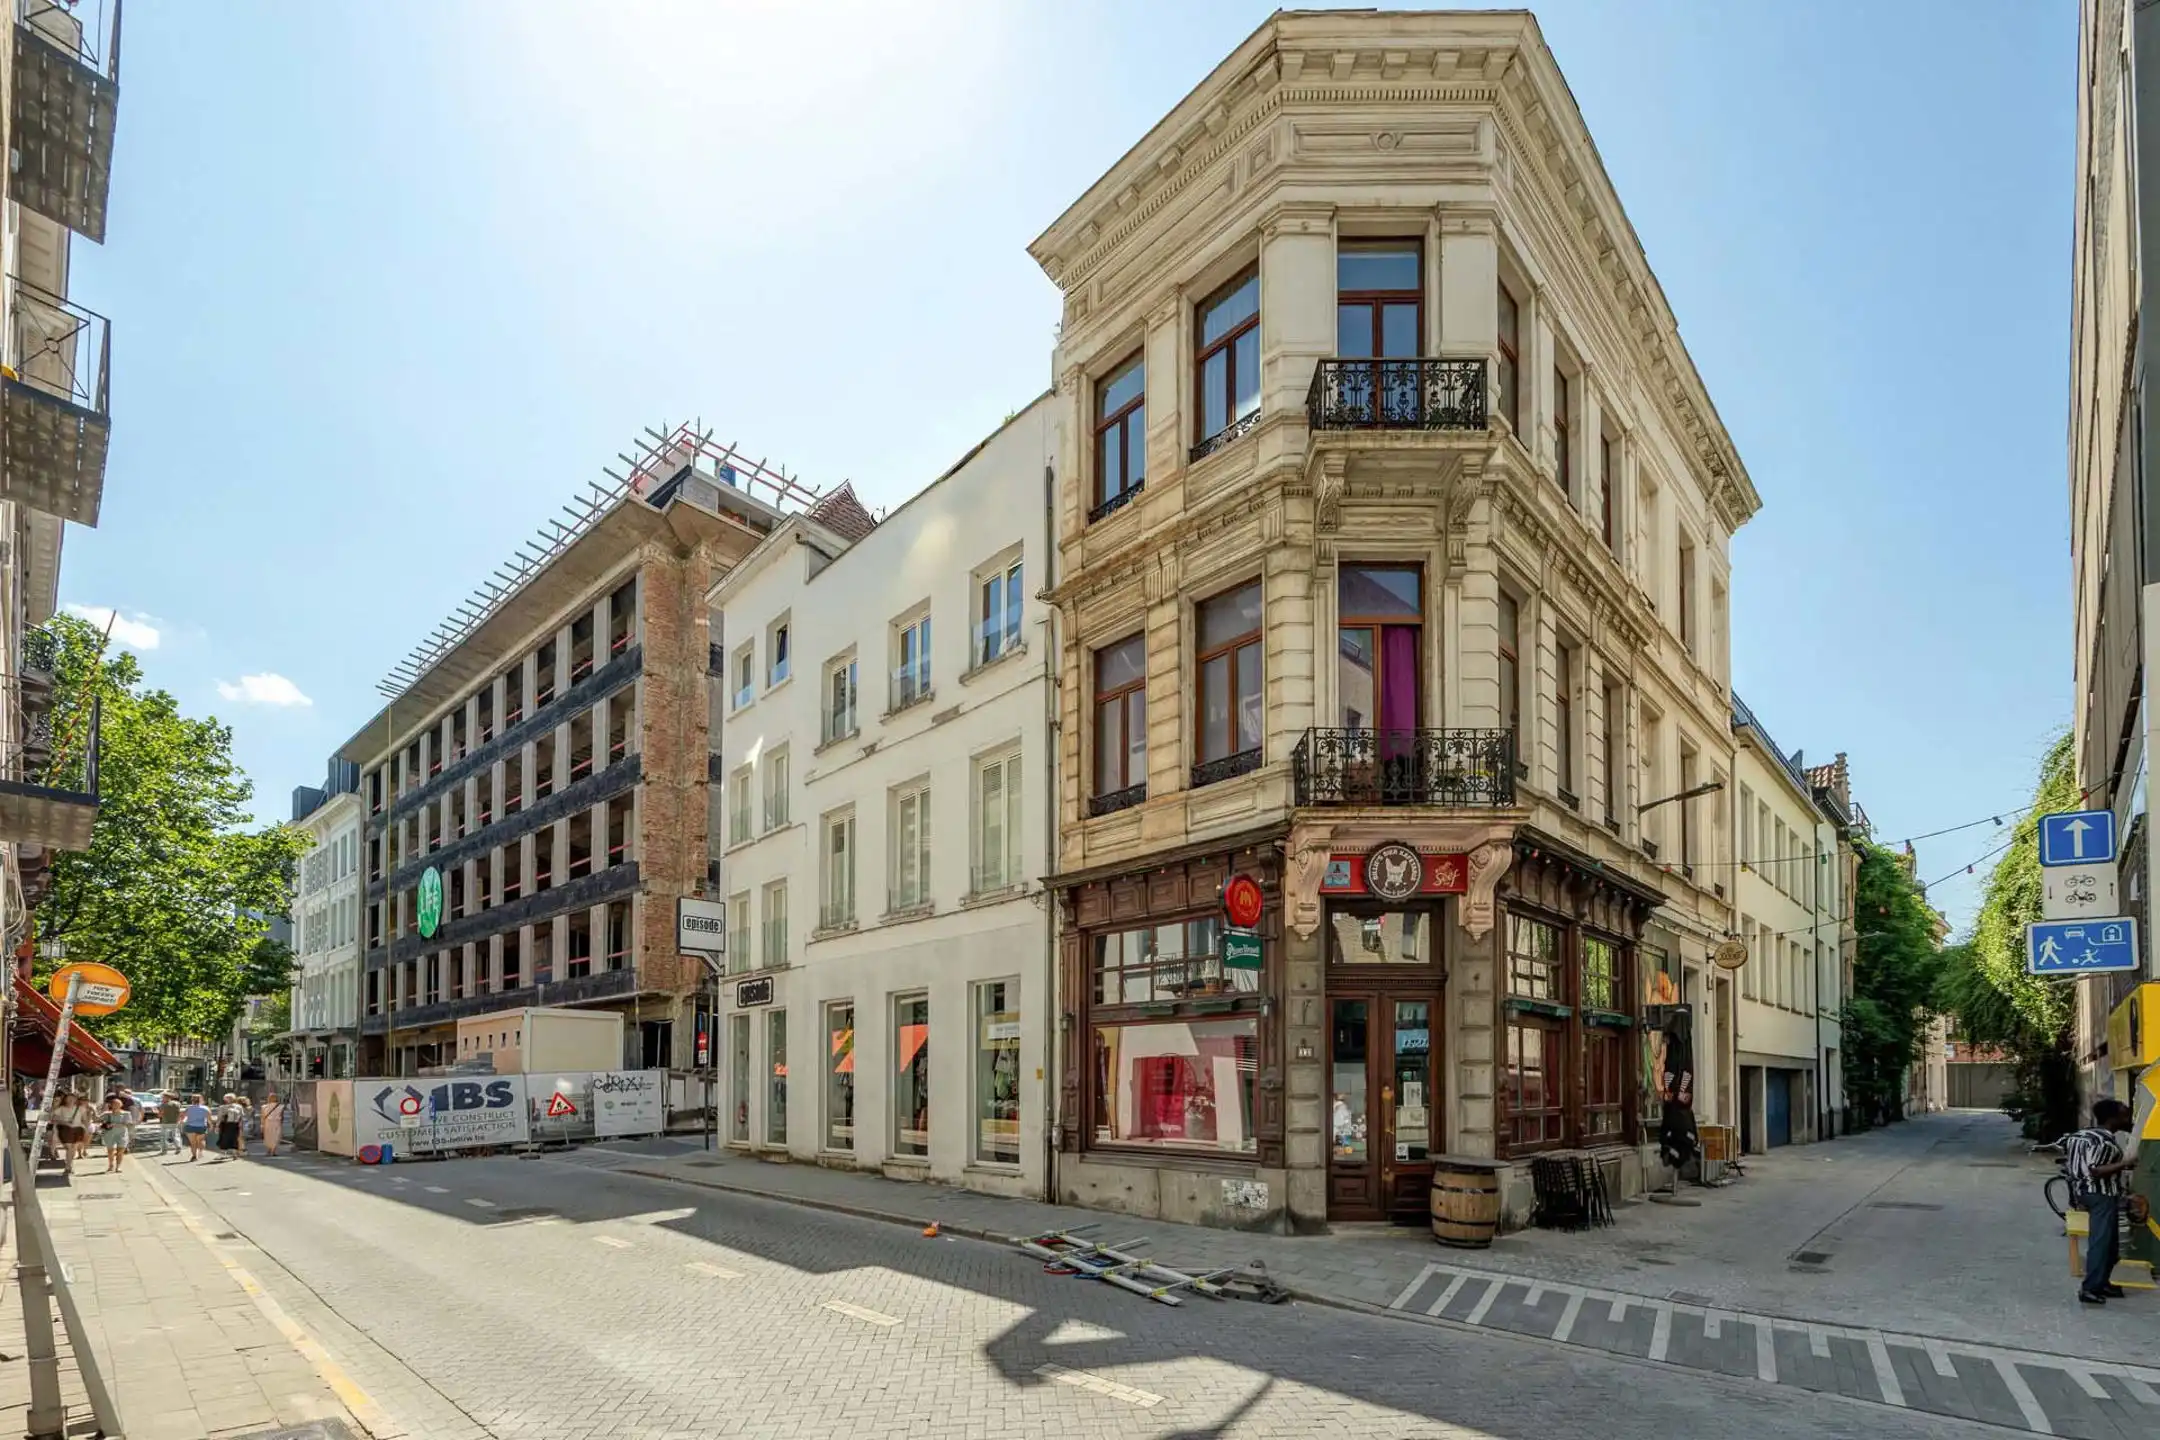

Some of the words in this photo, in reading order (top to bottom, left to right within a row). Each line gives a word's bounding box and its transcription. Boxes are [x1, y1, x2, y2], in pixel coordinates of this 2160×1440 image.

[686, 917, 719, 933] episode
[431, 1081, 514, 1111] IBS
[452, 1111, 514, 1122] CONSTRUCT
[444, 1121, 516, 1134] SATISFACTION
